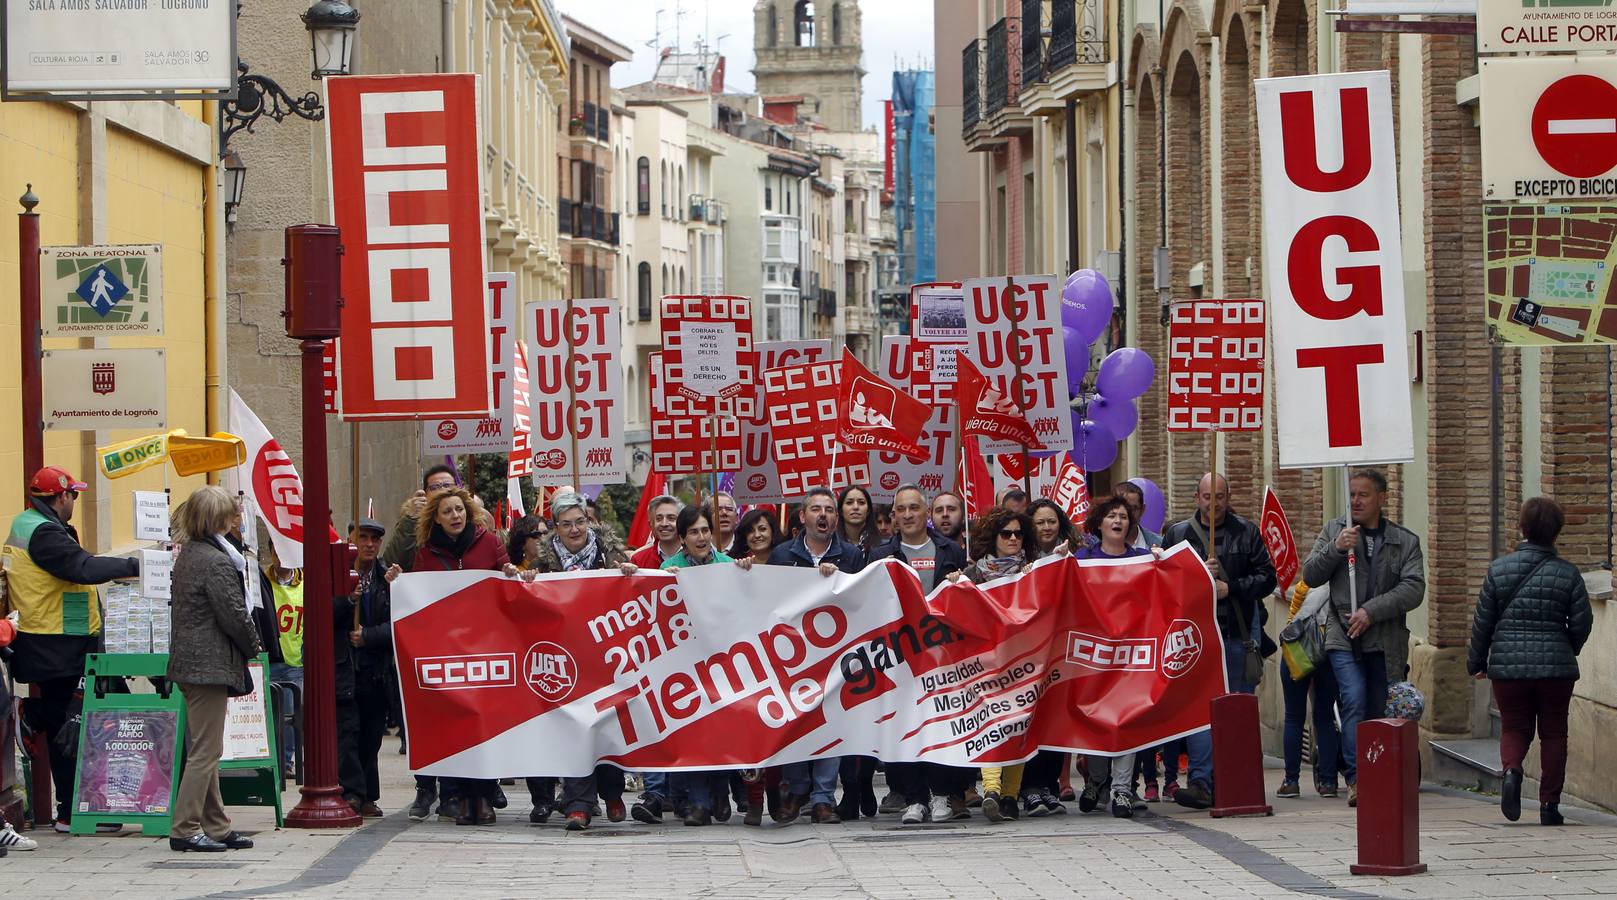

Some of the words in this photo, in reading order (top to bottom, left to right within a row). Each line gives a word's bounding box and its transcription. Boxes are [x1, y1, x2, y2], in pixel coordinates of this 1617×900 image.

[29, 0, 55, 11] SALA
[95, 0, 148, 10] SALVADOR
[1523, 12, 1581, 20] AYUNTAMIENTO
[1501, 26, 1559, 44] CALLE
[1567, 25, 1617, 42] PORT
[1514, 179, 1575, 196] EXCEPTO
[1279, 87, 1384, 449] UGT
[972, 283, 1049, 325] UGT
[116, 323, 148, 331] LOGROÑO
[536, 306, 610, 348] UGT
[977, 327, 1053, 370] UGT
[537, 353, 612, 394] UGT
[694, 373, 727, 381] DERECHO
[52, 408, 111, 417] Ayuntamiento
[112, 408, 122, 416] de
[124, 408, 158, 417] Logroño
[539, 399, 614, 441] UGT
[123, 440, 161, 462] ONCE
[588, 584, 683, 643] mayo
[532, 652, 567, 676] UGT
[605, 613, 695, 683] 2018
[840, 615, 963, 694] gana
[594, 605, 847, 746] Tiempo
[922, 657, 985, 692] Igualdad
[758, 678, 824, 728] de
[951, 697, 1012, 736] Mayores
